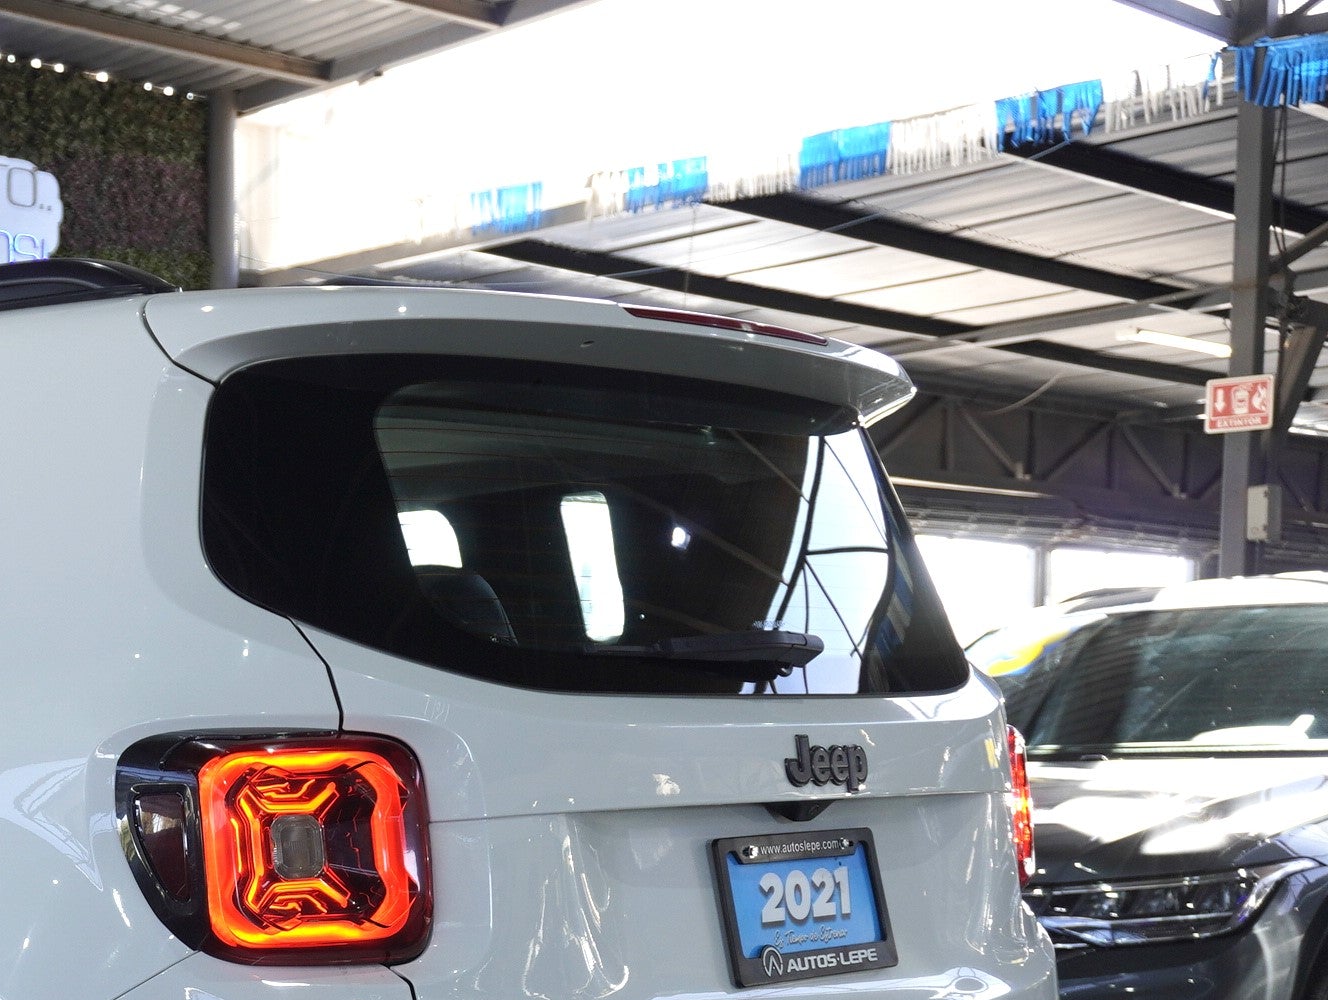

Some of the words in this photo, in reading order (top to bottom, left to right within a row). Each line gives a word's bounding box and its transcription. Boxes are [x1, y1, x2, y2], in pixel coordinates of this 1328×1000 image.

[784, 733, 868, 793] Jeep
[760, 838, 840, 856] www.autoslepe.com
[759, 866, 851, 923] 2021
